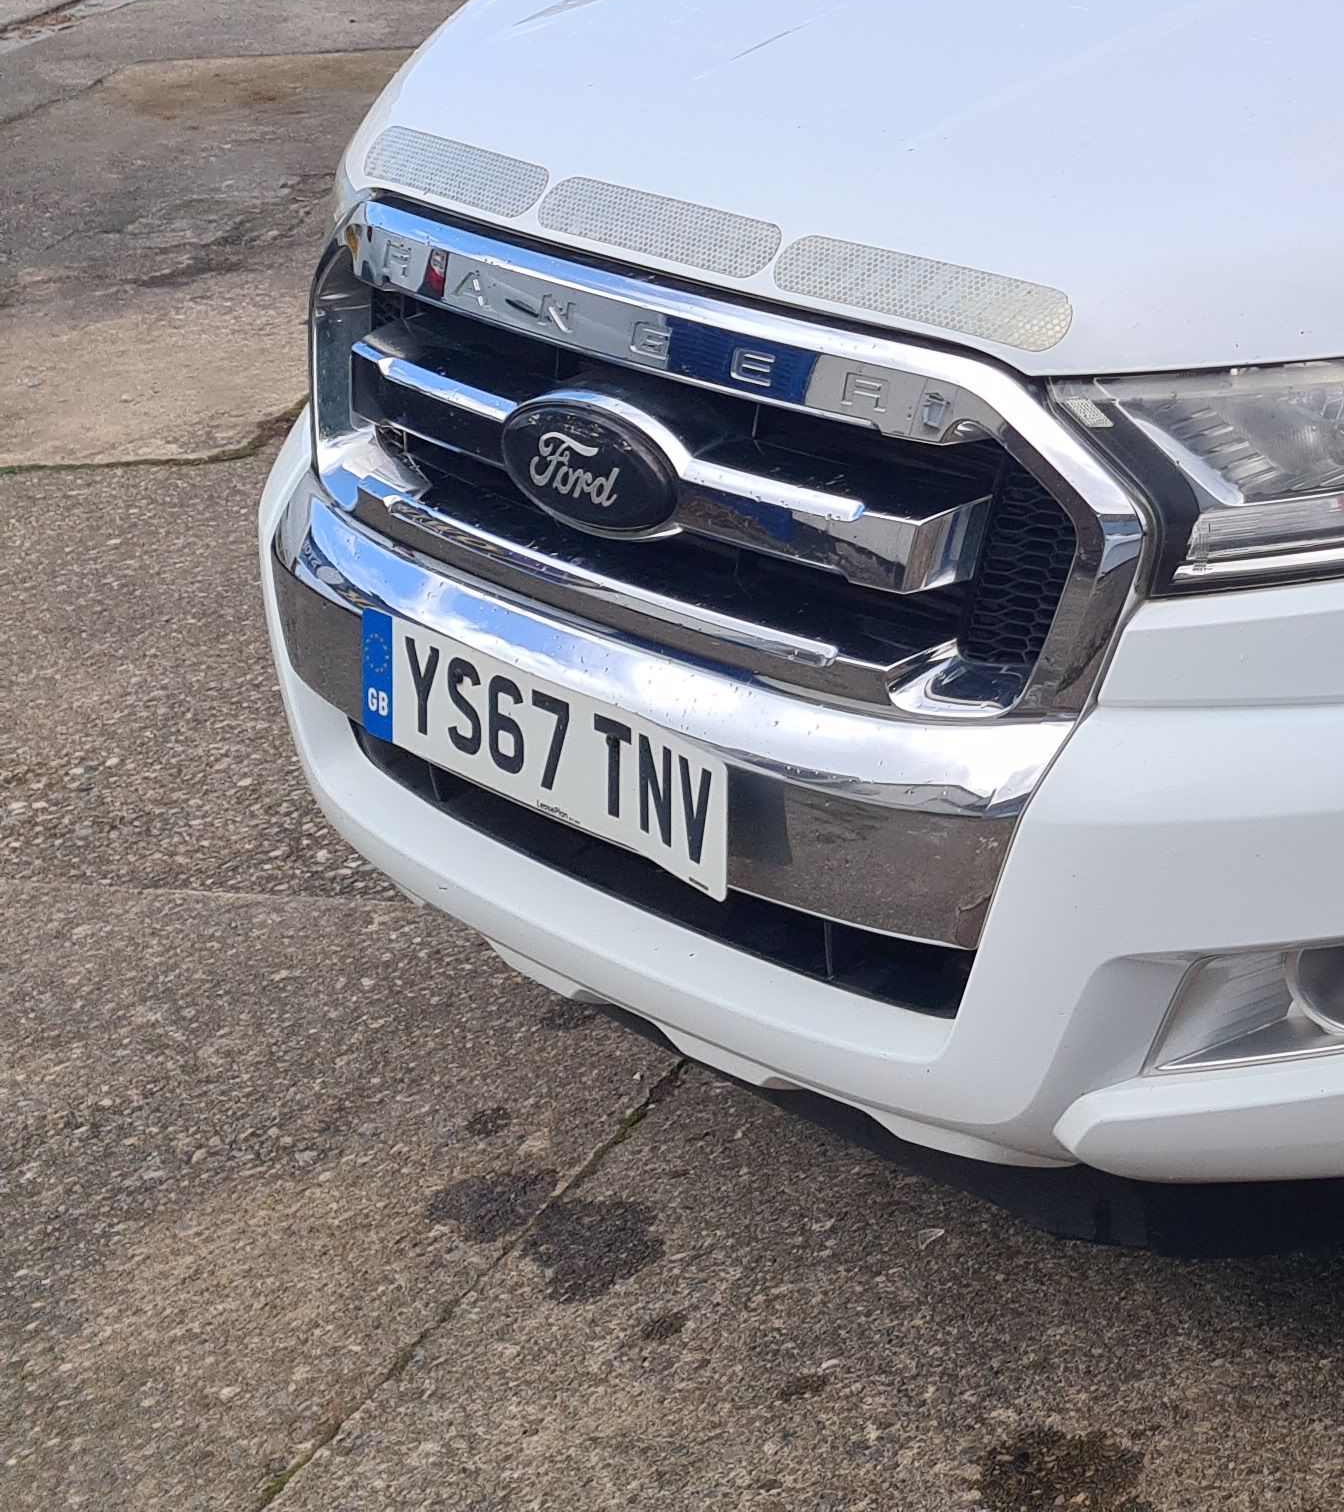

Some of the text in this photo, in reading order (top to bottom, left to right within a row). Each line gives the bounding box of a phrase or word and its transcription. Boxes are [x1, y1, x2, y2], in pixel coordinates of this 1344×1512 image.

[386, 239, 888, 414] RANGER
[529, 431, 622, 507] Ford
[366, 686, 389, 717] GB
[404, 635, 713, 866] YS67 TNV
